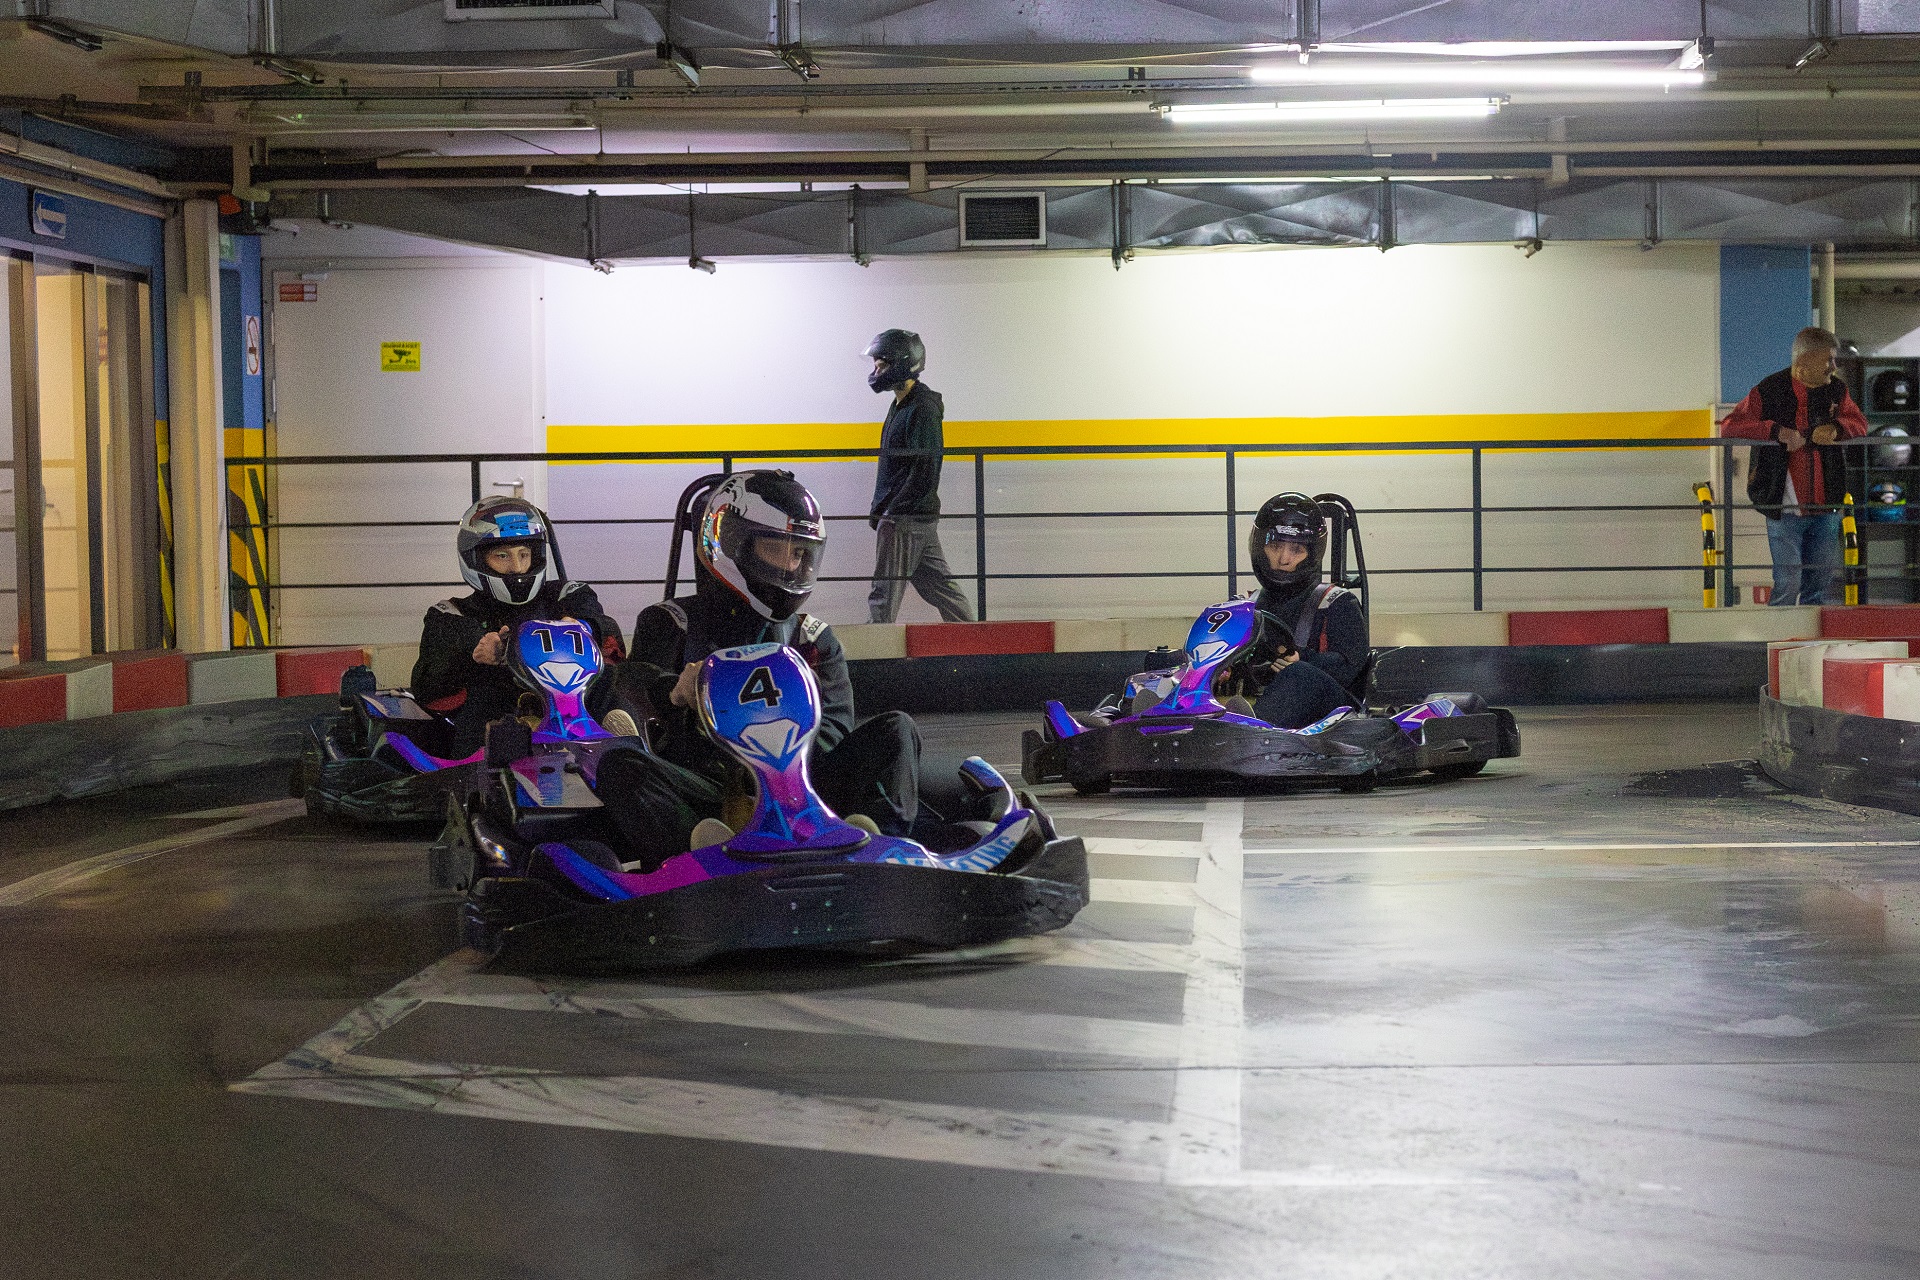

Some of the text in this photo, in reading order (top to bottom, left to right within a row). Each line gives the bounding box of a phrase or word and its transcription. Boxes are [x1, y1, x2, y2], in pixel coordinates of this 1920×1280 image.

[1207, 610, 1232, 633] 9
[531, 628, 584, 656] 11
[738, 666, 783, 708] 4
